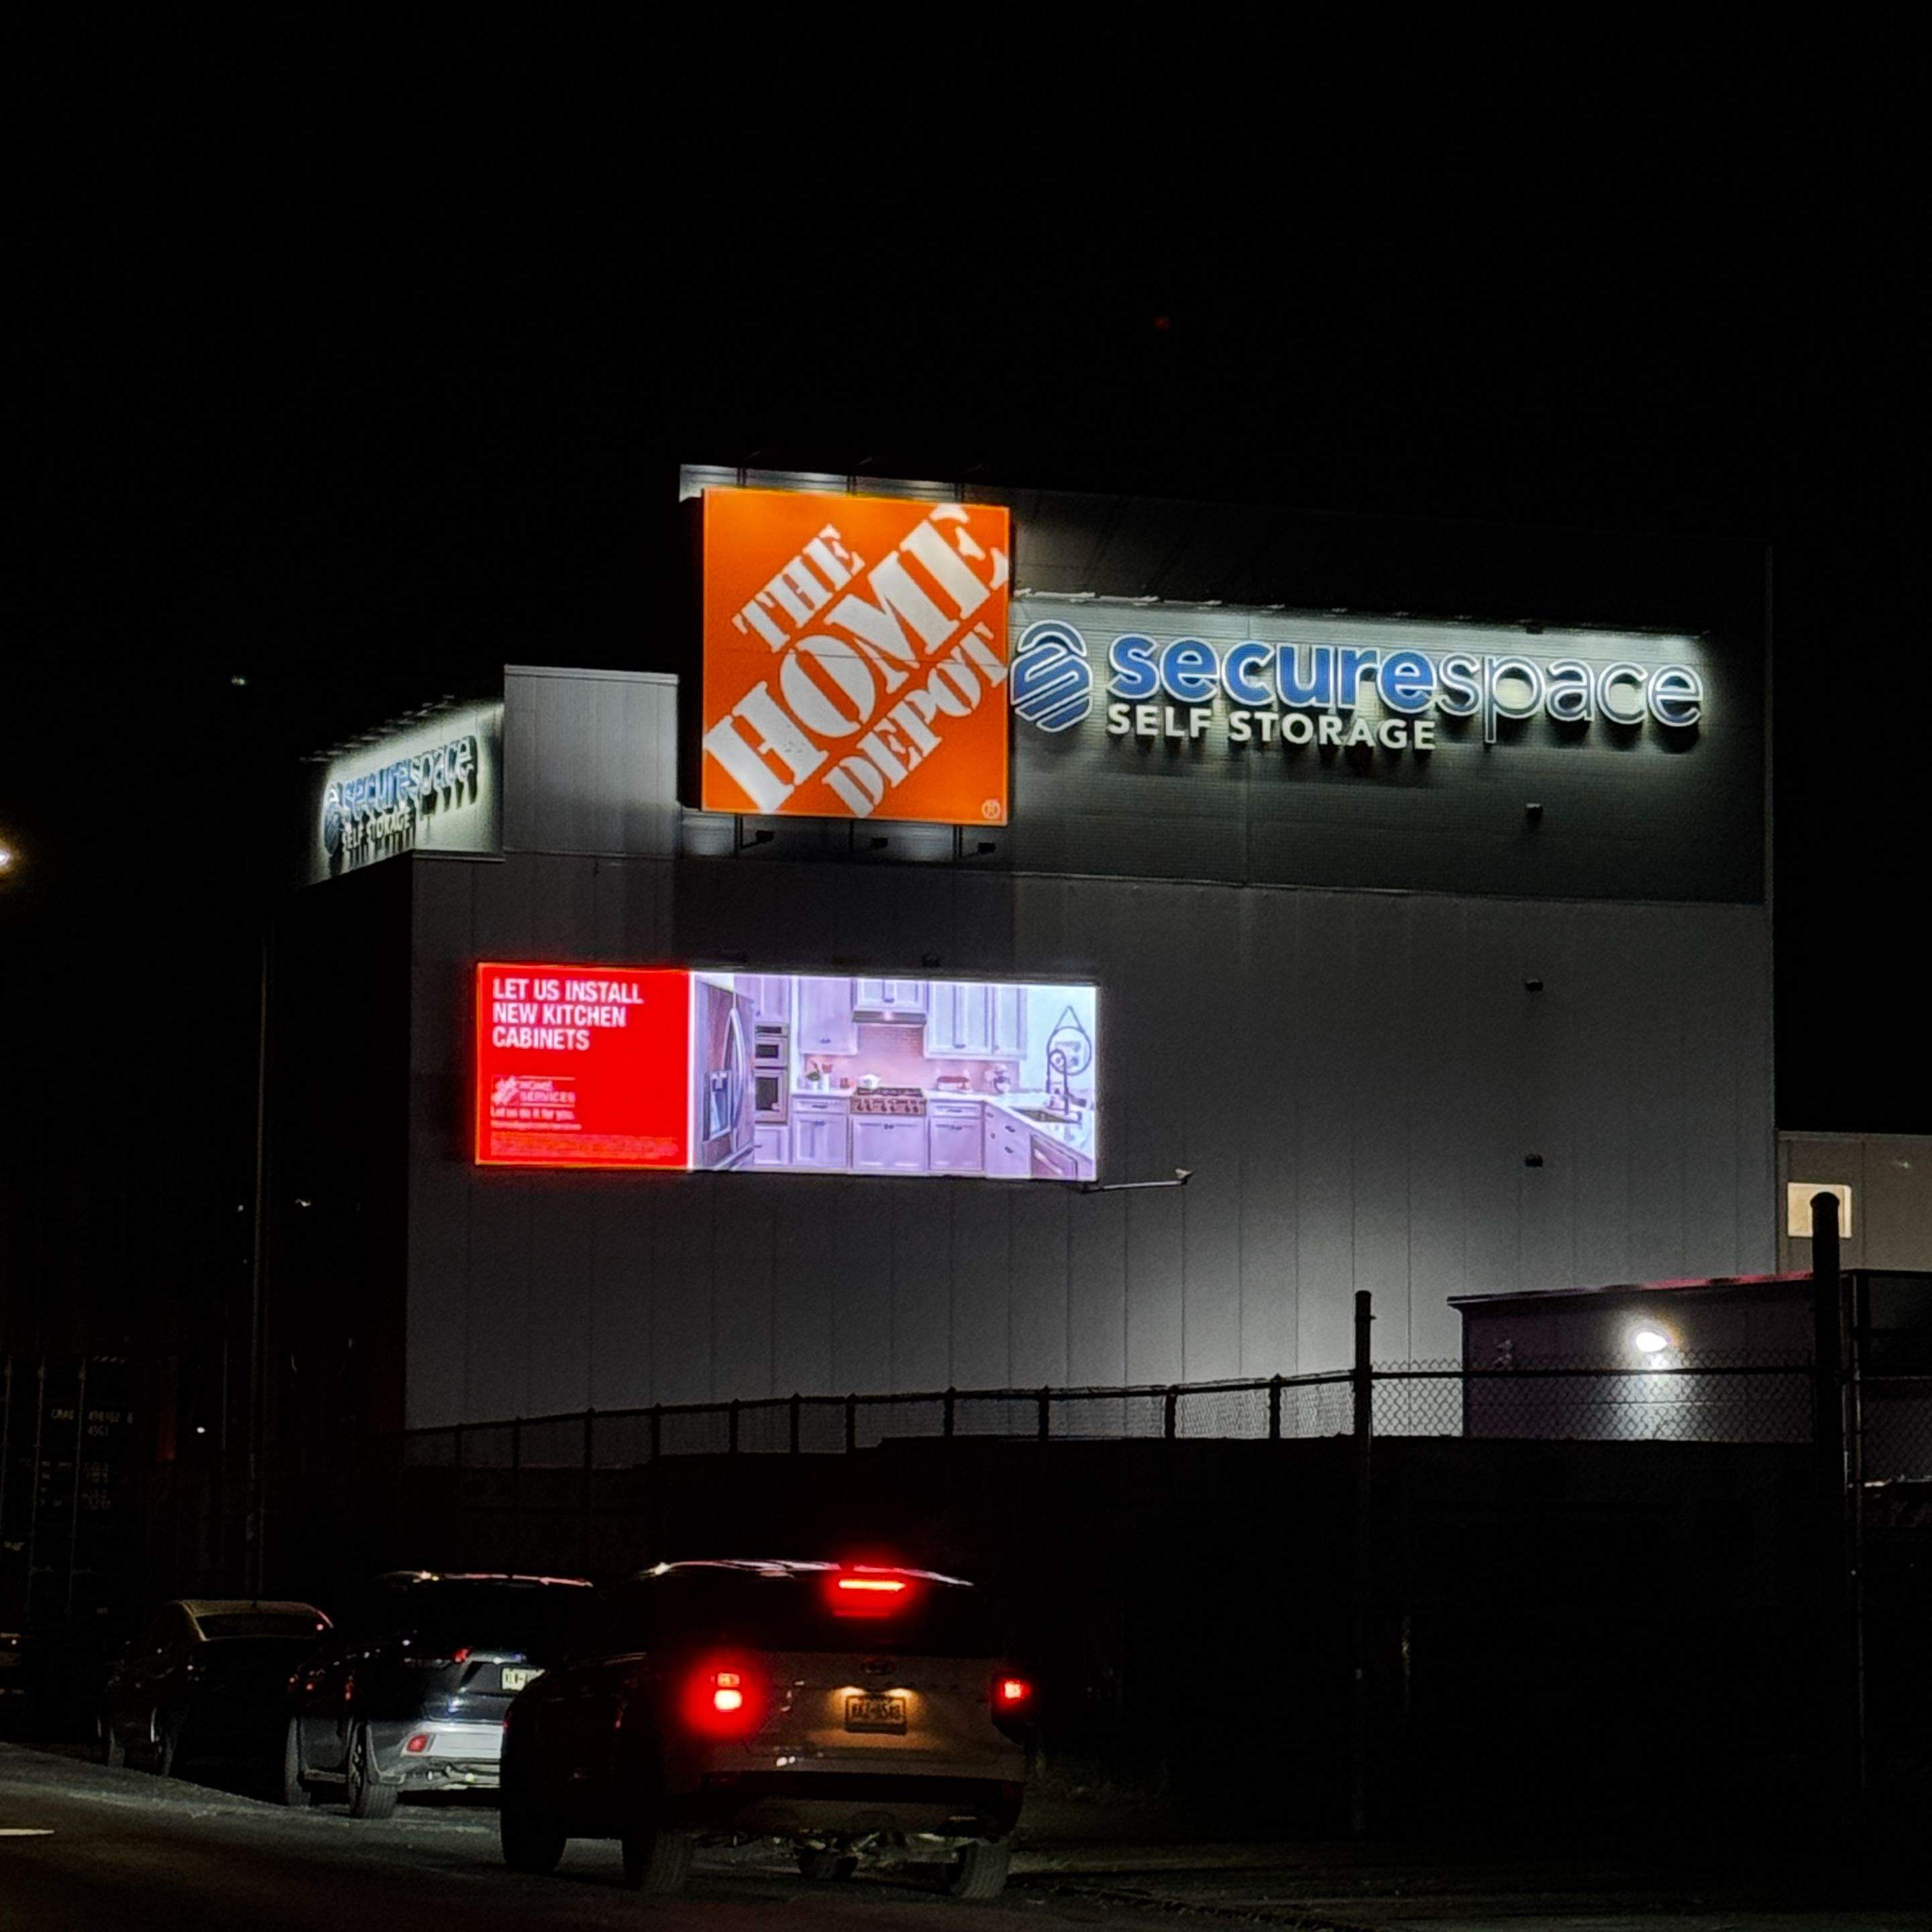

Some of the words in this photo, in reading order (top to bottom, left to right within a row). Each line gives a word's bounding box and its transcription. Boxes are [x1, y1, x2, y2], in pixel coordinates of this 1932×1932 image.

[732, 524, 865, 653] THE
[704, 502, 1008, 814] HOME
[1106, 633, 1704, 744] securespace
[822, 621, 1008, 818] DEPOT
[1107, 702, 1212, 738] SELF
[1229, 708, 1437, 751] STORAGE
[492, 977, 530, 1000] LET
[533, 978, 559, 1001] US
[565, 979, 644, 1005] INSTALL
[492, 1002, 537, 1024] NEW
[543, 1004, 627, 1028] KITCHEN
[492, 1026, 590, 1051] CABINETS
